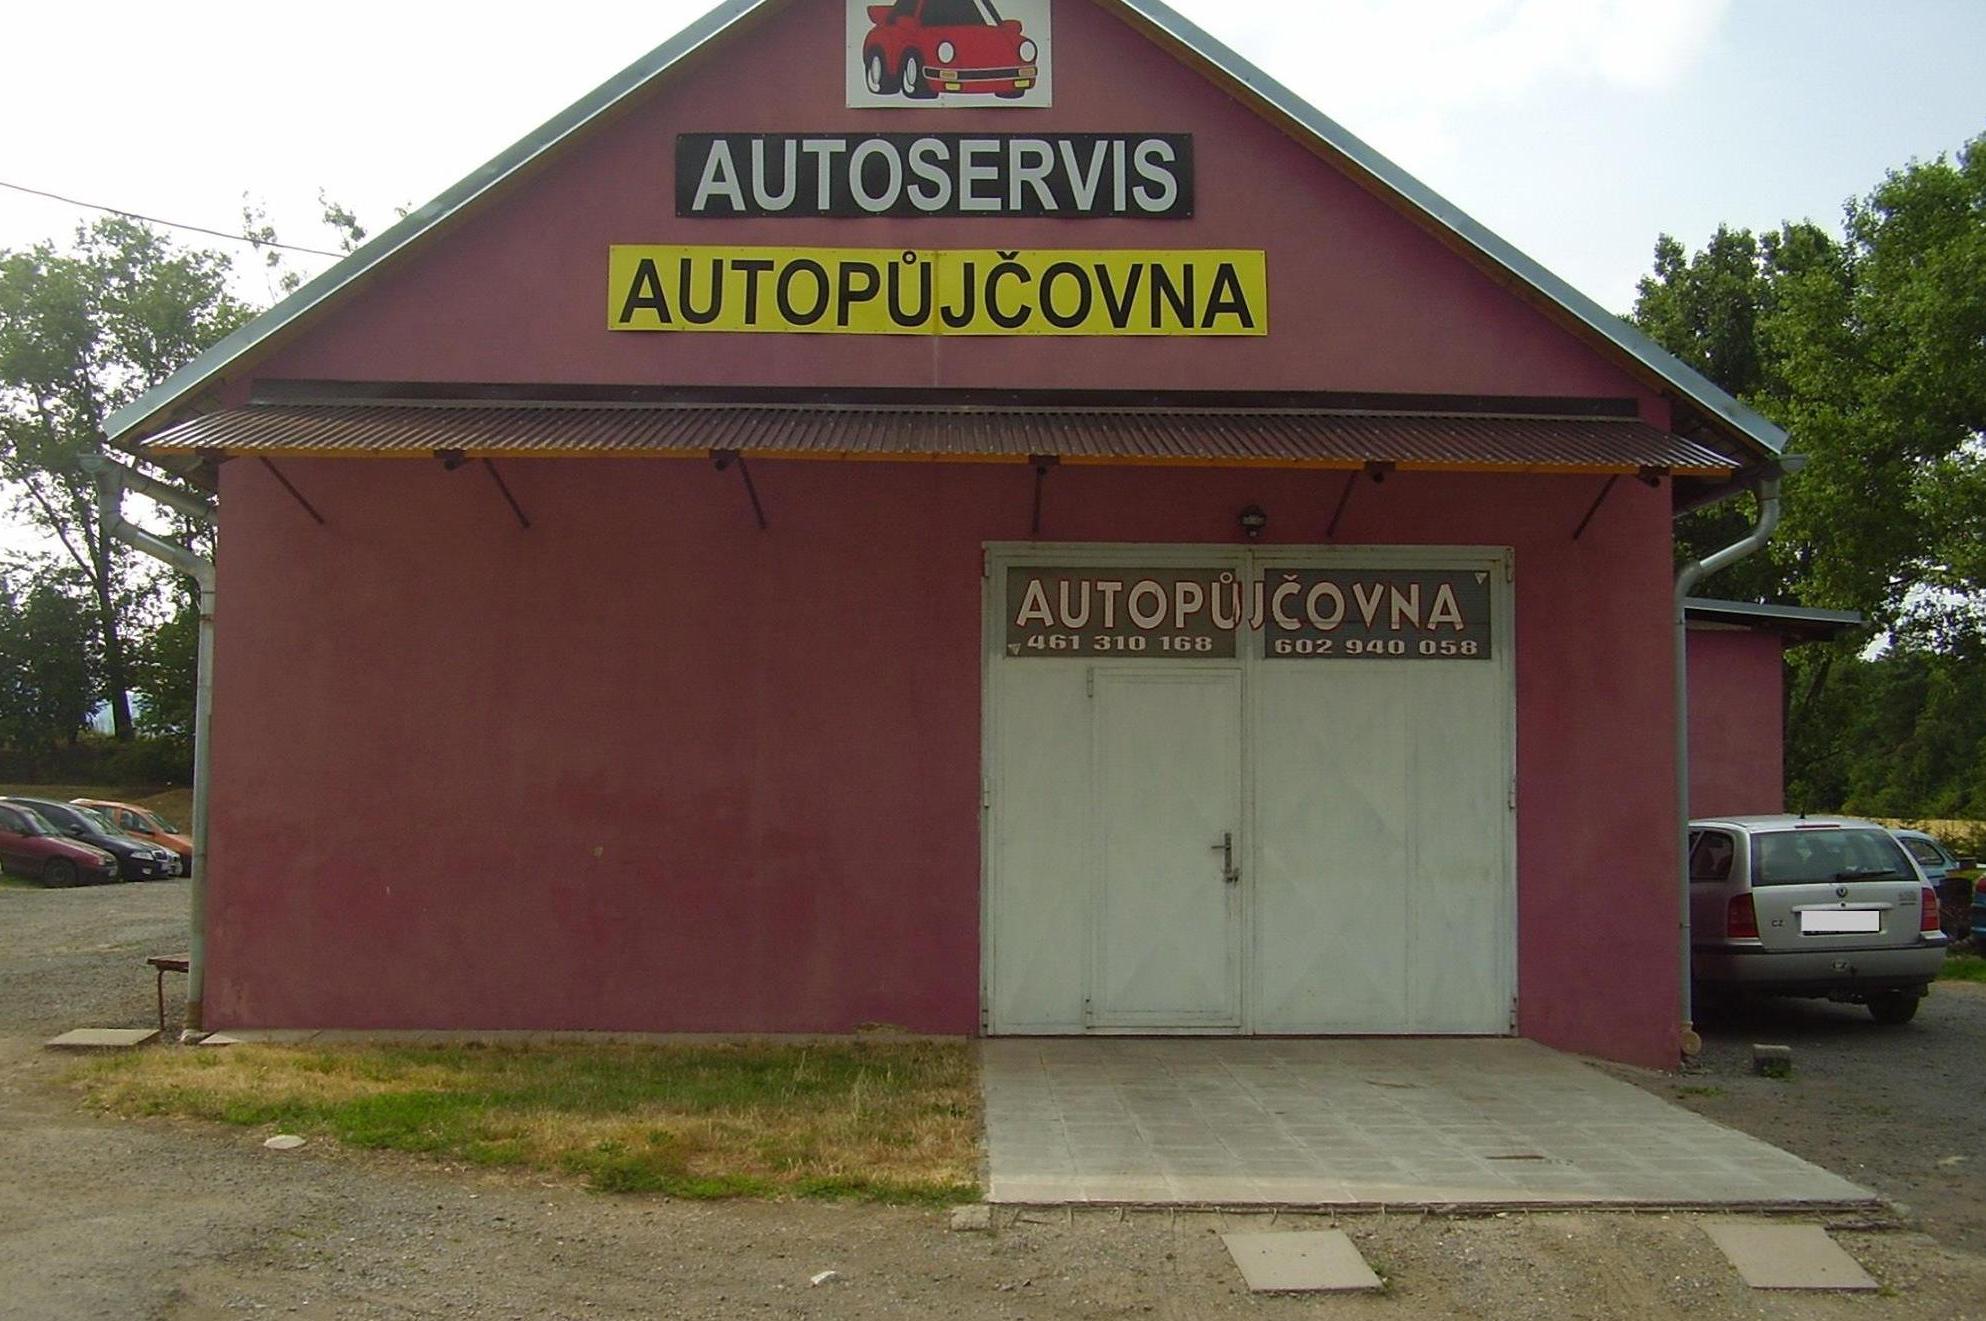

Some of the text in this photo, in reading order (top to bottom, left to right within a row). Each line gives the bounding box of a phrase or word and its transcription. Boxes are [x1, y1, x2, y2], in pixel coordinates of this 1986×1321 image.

[691, 138, 1178, 212] AUTOSERVIS
[618, 249, 1255, 329] AUTOPŮJČOVNA
[1015, 571, 1465, 630] AUTOPŮJČOVNA
[1027, 635, 1213, 651] 461 310 168
[1274, 638, 1478, 655] 602 940 058
